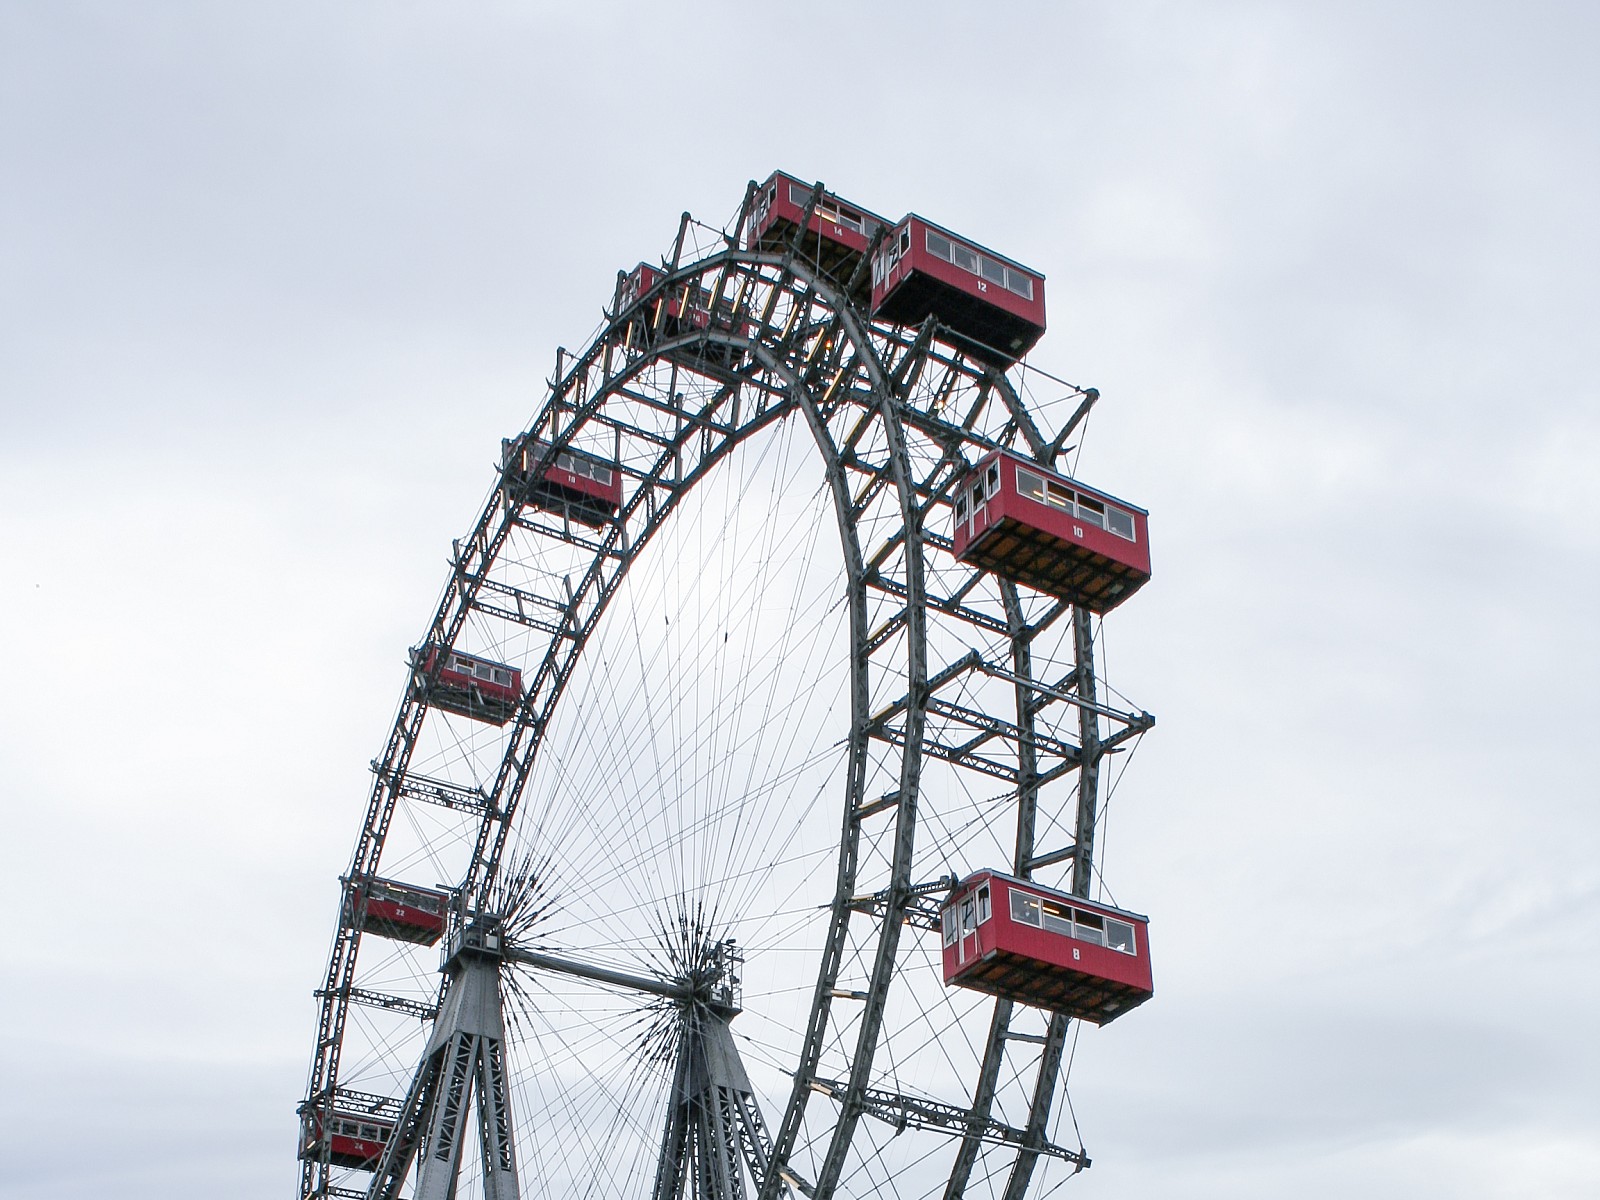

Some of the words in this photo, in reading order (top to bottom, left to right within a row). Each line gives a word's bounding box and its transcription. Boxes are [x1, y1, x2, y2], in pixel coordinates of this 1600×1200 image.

[834, 226, 843, 236] 14
[977, 280, 987, 292] 12
[1073, 525, 1083, 539] 10
[1072, 948, 1080, 960] 8
